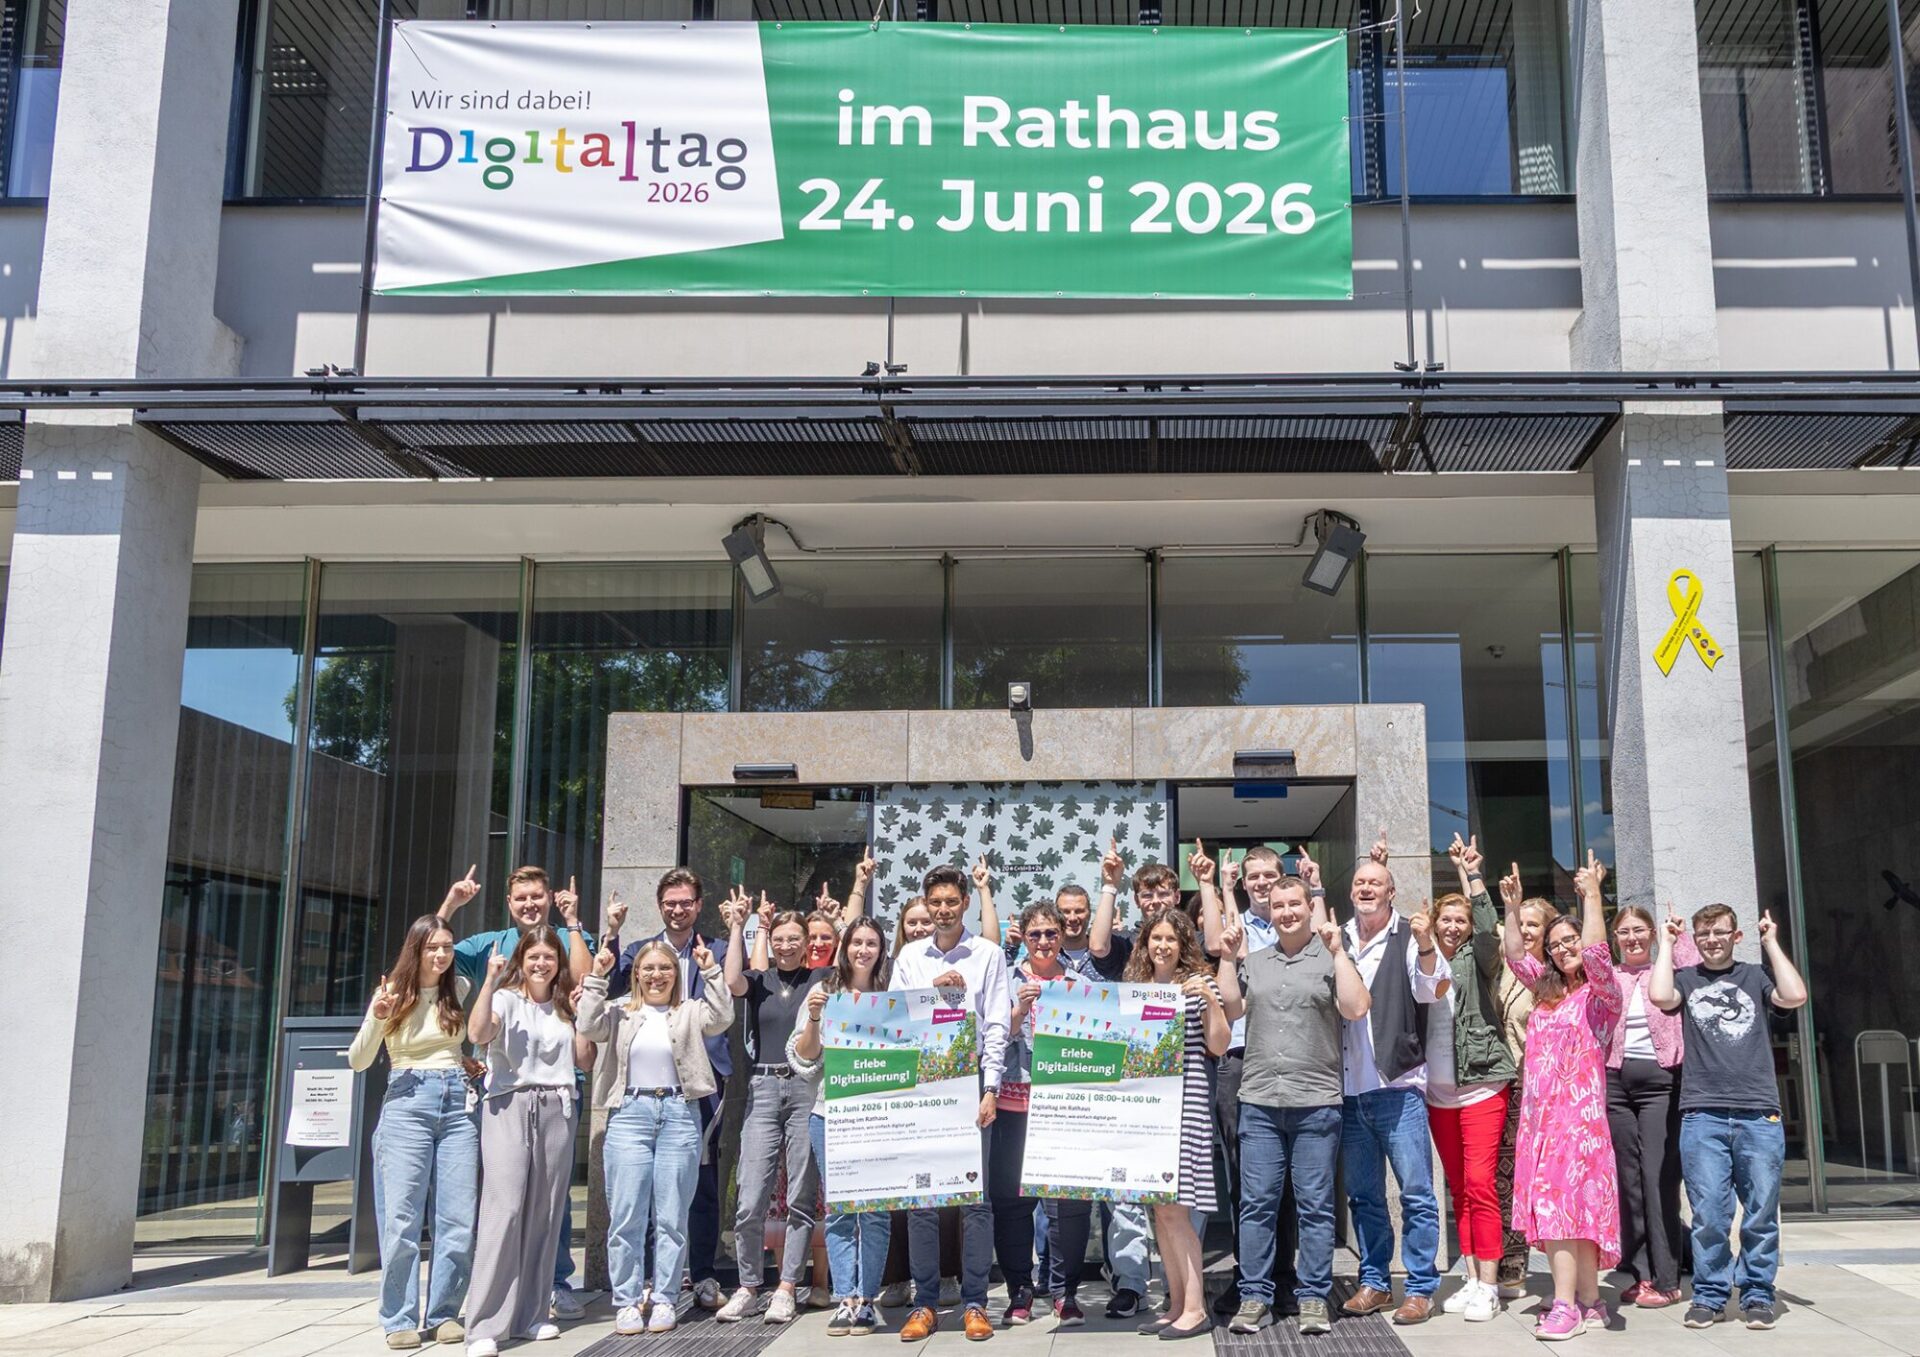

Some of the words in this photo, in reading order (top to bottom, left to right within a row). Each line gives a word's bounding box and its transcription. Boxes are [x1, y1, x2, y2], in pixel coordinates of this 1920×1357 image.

[410, 89, 453, 110] Wir
[459, 87, 508, 110] sind
[515, 88, 590, 110] dabei!
[838, 88, 932, 146] im
[965, 95, 1280, 152] Rathaus
[405, 120, 748, 192] Digitaltag
[647, 181, 709, 203] 2026
[799, 177, 914, 233] 24.
[937, 175, 1103, 234] Juni
[1130, 180, 1315, 235] 2026
[1132, 989, 1177, 1001] Digitaltag
[1061, 1047, 1094, 1059] Erlebe
[853, 1058, 887, 1070] Erlebe
[1037, 1060, 1116, 1076] Digitalisierung!
[829, 1070, 910, 1088] Digitalisierung!
[828, 1105, 841, 1114] 24.
[842, 1104, 859, 1113] Juni
[861, 1102, 882, 1111] 2026
[943, 1097, 958, 1106] Uhr
[1032, 1092, 1045, 1100] 24.
[1047, 1092, 1063, 1100] Juni
[1065, 1093, 1085, 1101] 2026
[1146, 1095, 1162, 1104] Uhr
